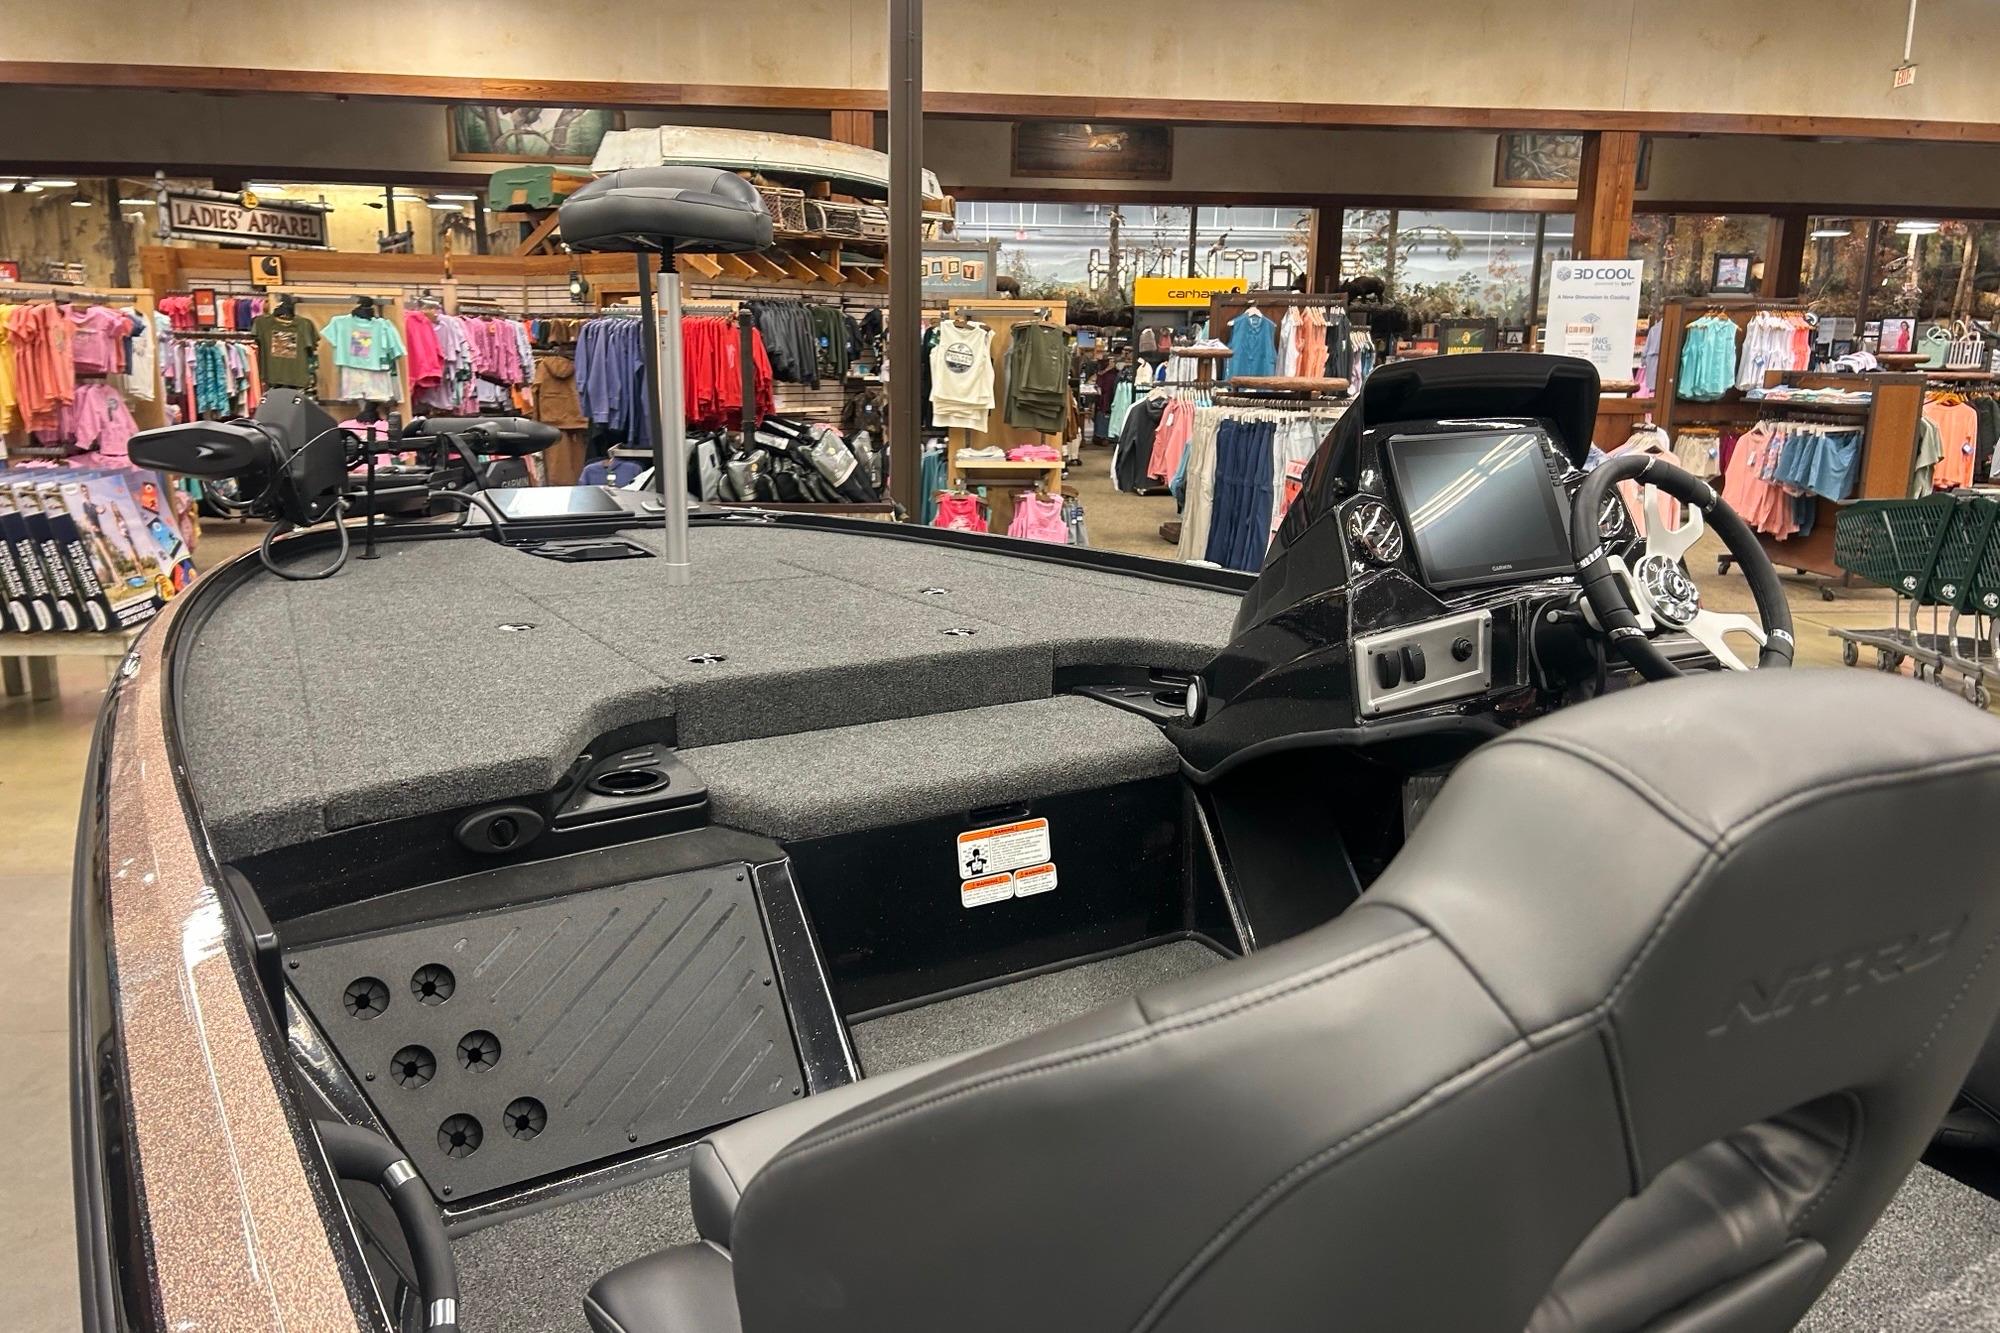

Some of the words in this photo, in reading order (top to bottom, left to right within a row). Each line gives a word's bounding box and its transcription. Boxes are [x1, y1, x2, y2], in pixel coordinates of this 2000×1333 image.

[175, 204, 242, 230] LADIES'
[248, 212, 318, 238] APPAREL
[1573, 268, 1594, 280] 3D
[1595, 268, 1635, 280] COOL
[1168, 289, 1229, 299] carha
